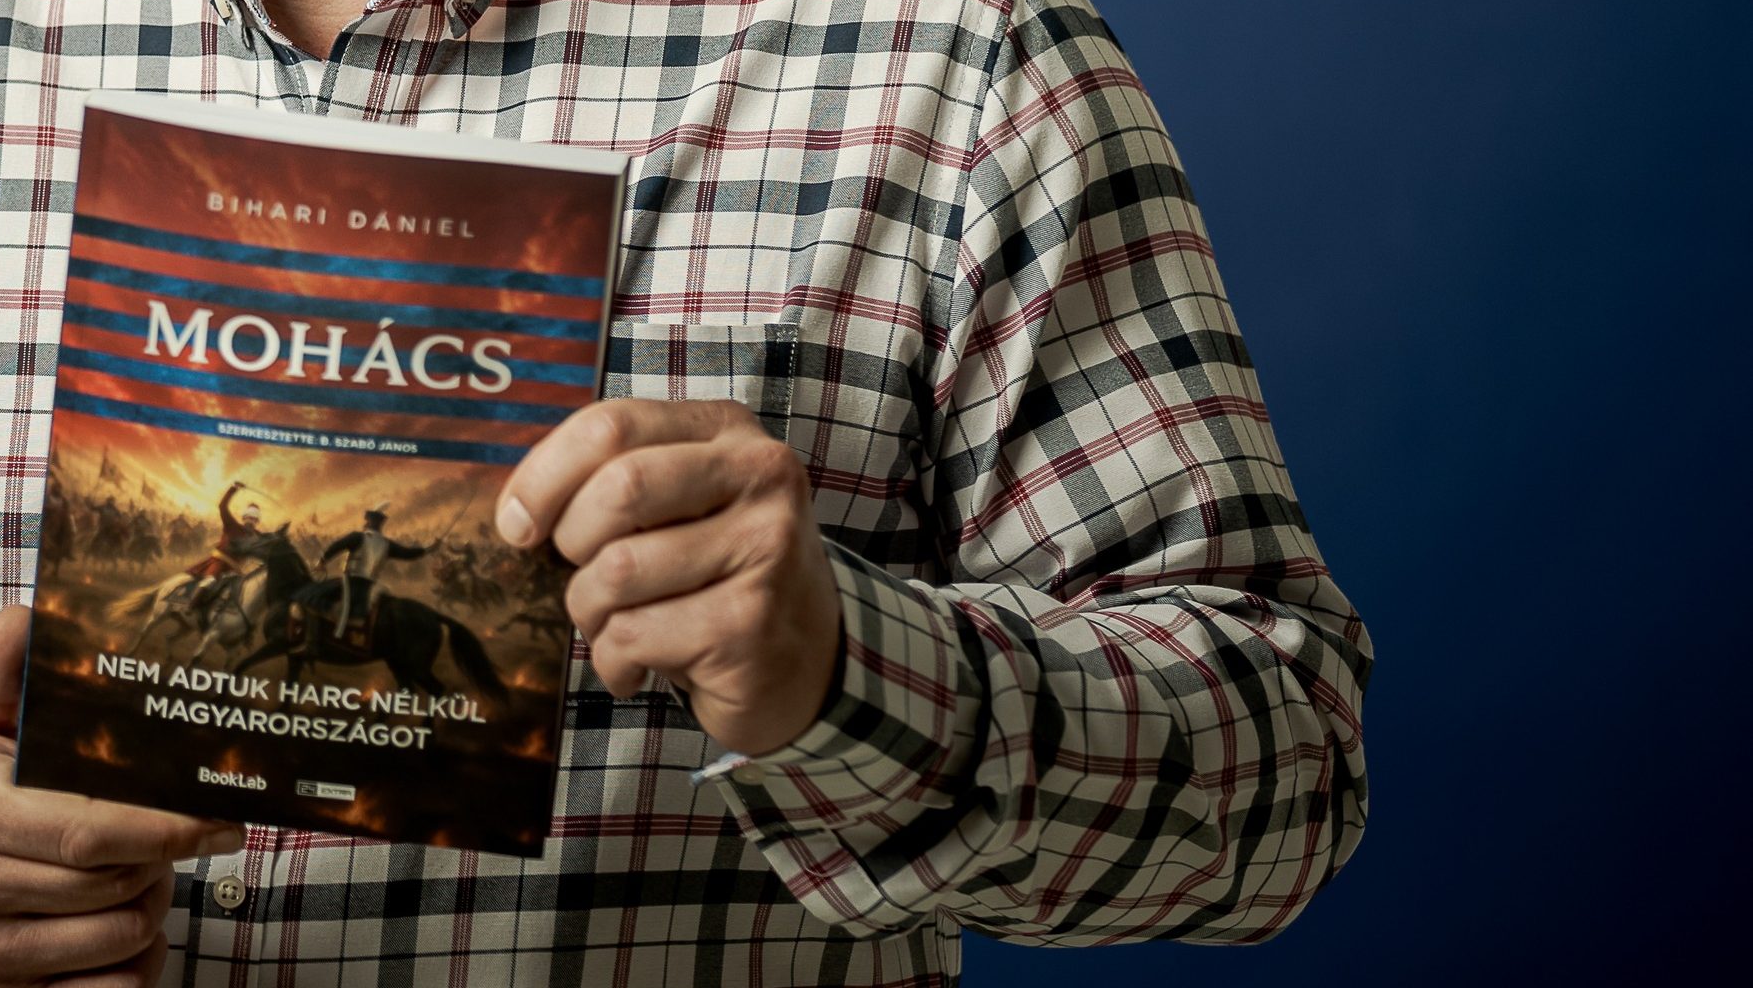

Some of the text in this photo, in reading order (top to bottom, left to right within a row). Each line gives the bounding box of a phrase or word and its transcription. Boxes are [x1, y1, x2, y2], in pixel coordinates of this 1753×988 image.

[208, 191, 475, 239] BIHARI DÁNIEL
[144, 299, 513, 394] MOHÁCS
[334, 436, 376, 450] SZABÓ
[97, 653, 487, 723] NEM ADTUK HARC NÉLKÜL
[145, 696, 432, 750] MAGYARORSZÁGOT
[199, 766, 267, 791] BookLab
